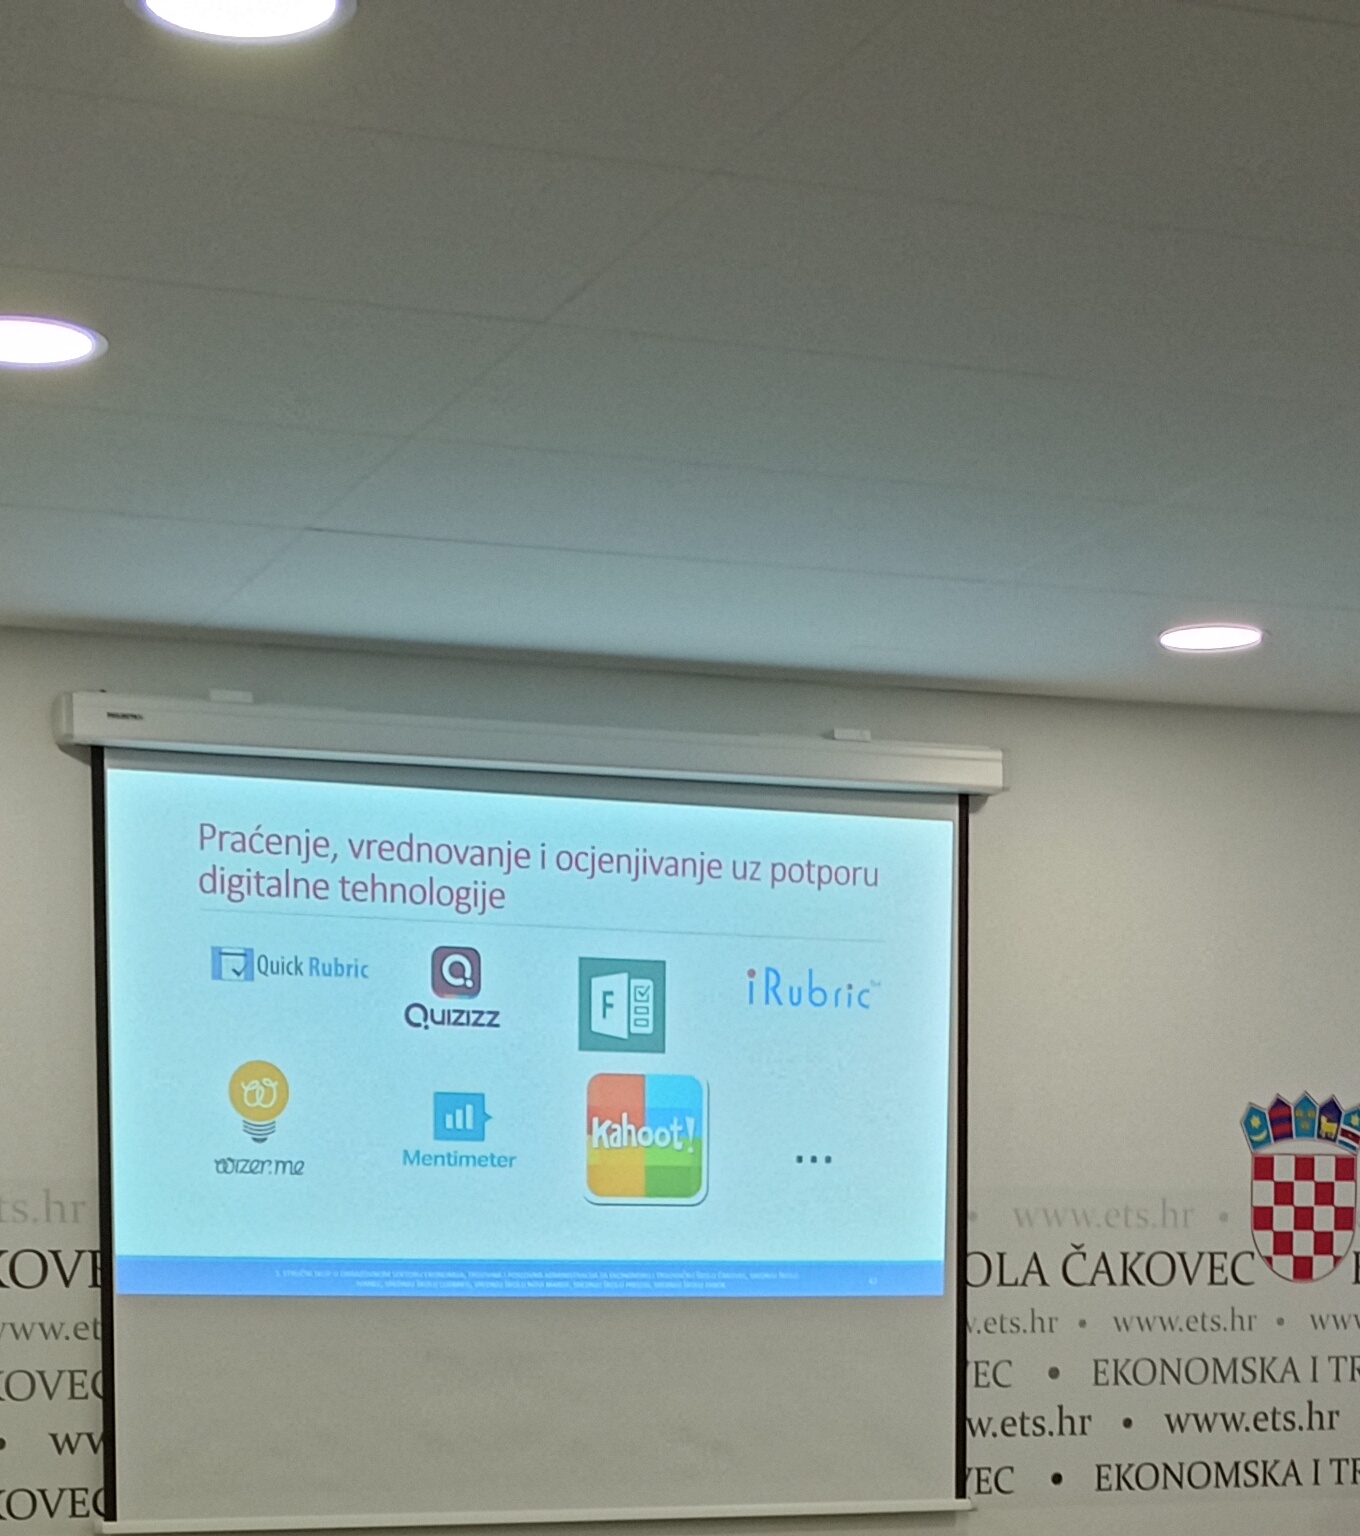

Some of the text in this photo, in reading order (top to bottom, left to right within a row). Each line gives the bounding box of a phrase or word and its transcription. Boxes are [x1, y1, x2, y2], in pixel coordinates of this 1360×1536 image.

[198, 823, 880, 890] Praćenje, vrednovanje i ocjenjivanje uz potporu
[198, 865, 507, 915] digitalne tehnologije
[257, 954, 369, 980] Quick Rubric
[402, 1149, 517, 1169] Mentimeter
[1061, 1243, 1256, 1288] ČAKOVEC
[1113, 1306, 1258, 1334] www.ets.hr
[1092, 1355, 1301, 1387] EKONOMSKA
[1311, 1355, 1319, 1384] I
[1165, 1401, 1340, 1434] www.ets.hr
[1095, 1459, 1302, 1492] EKONOMSKA
[1312, 1461, 1321, 1487] I
